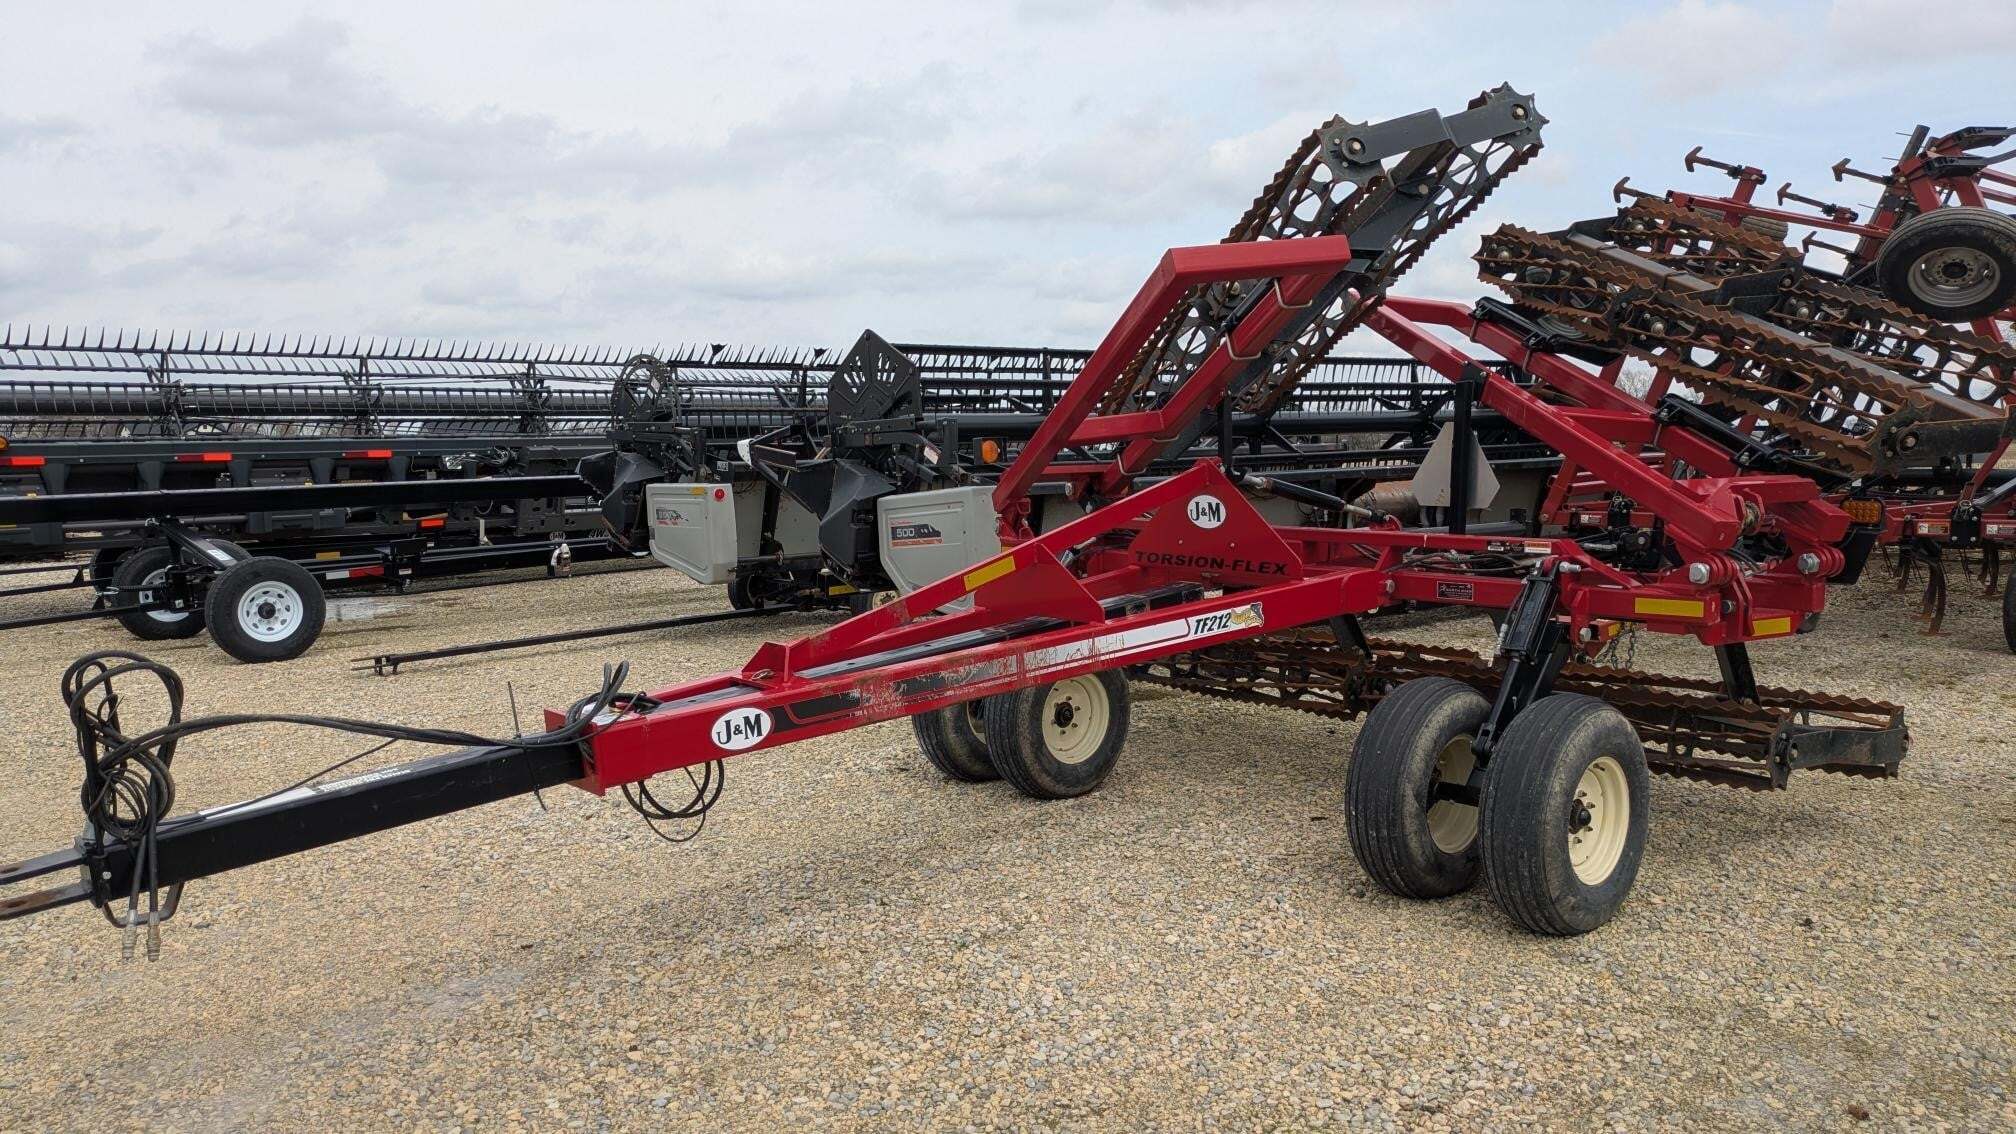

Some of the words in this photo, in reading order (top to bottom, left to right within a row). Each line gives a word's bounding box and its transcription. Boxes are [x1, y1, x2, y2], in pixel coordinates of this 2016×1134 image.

[1189, 501, 1222, 523] J&M
[896, 528, 915, 538] 500
[1135, 551, 1288, 576] TORSION-FLEX
[1193, 612, 1232, 636] TF212
[715, 713, 763, 745] J&M
